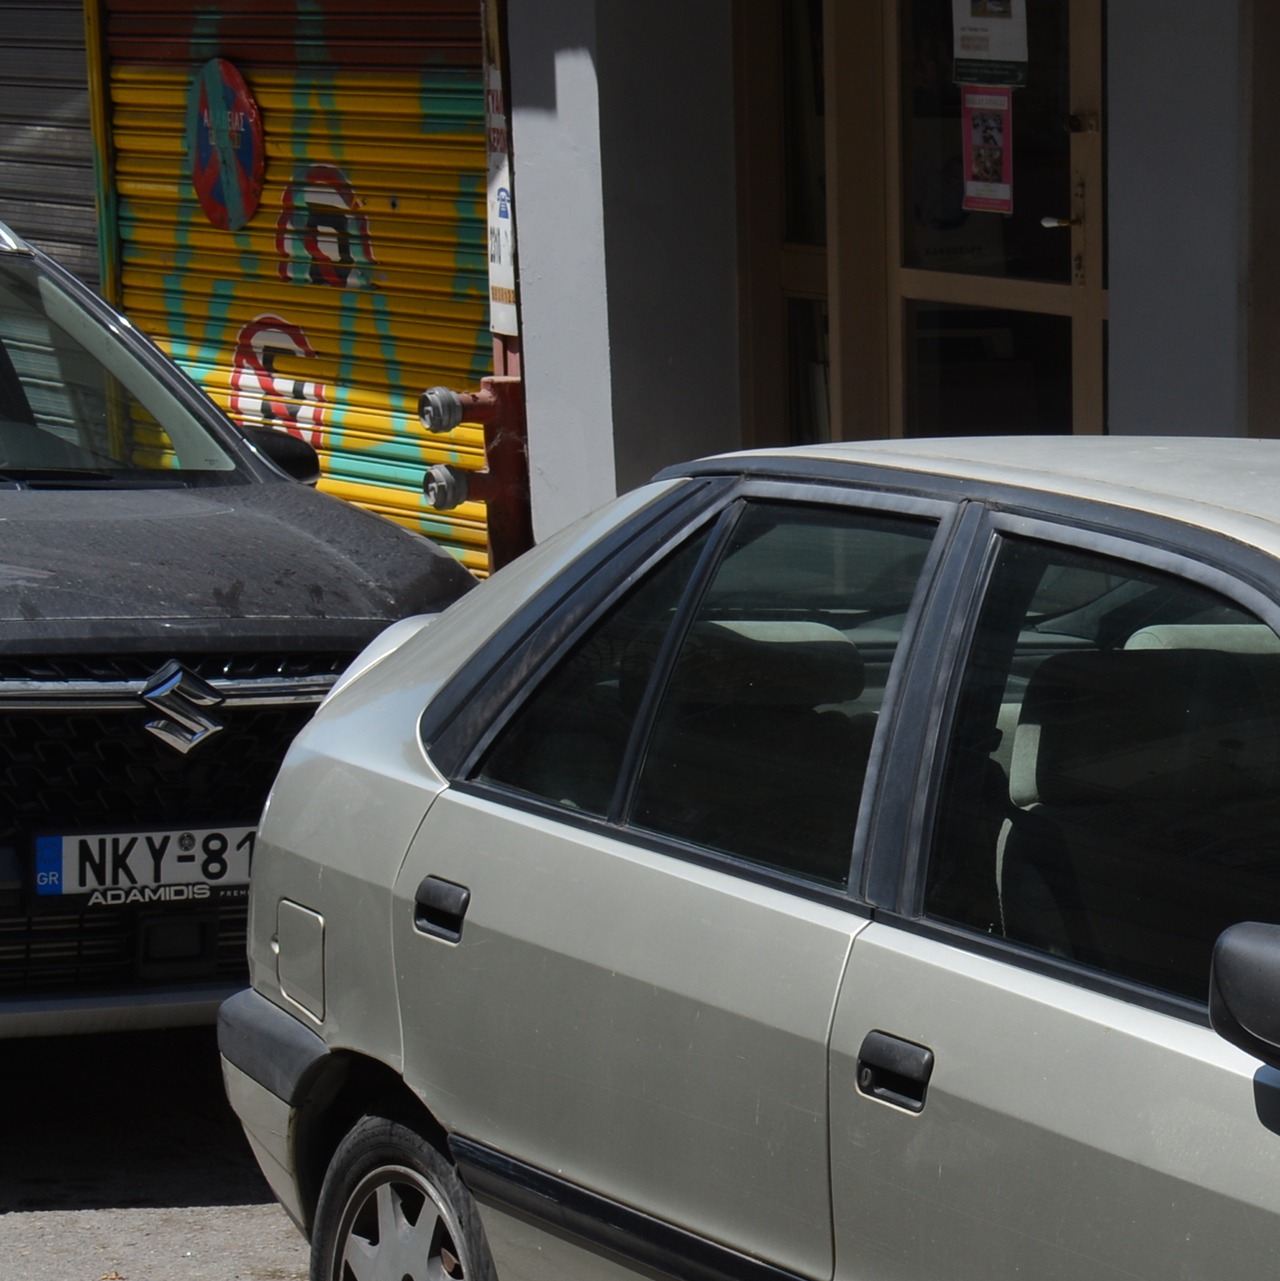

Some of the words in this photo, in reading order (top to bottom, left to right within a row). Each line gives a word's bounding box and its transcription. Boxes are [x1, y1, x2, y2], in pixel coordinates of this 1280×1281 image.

[37, 871, 59, 886] GR
[88, 883, 211, 906] ADAMIDIS
[220, 888, 250, 897] PREM
